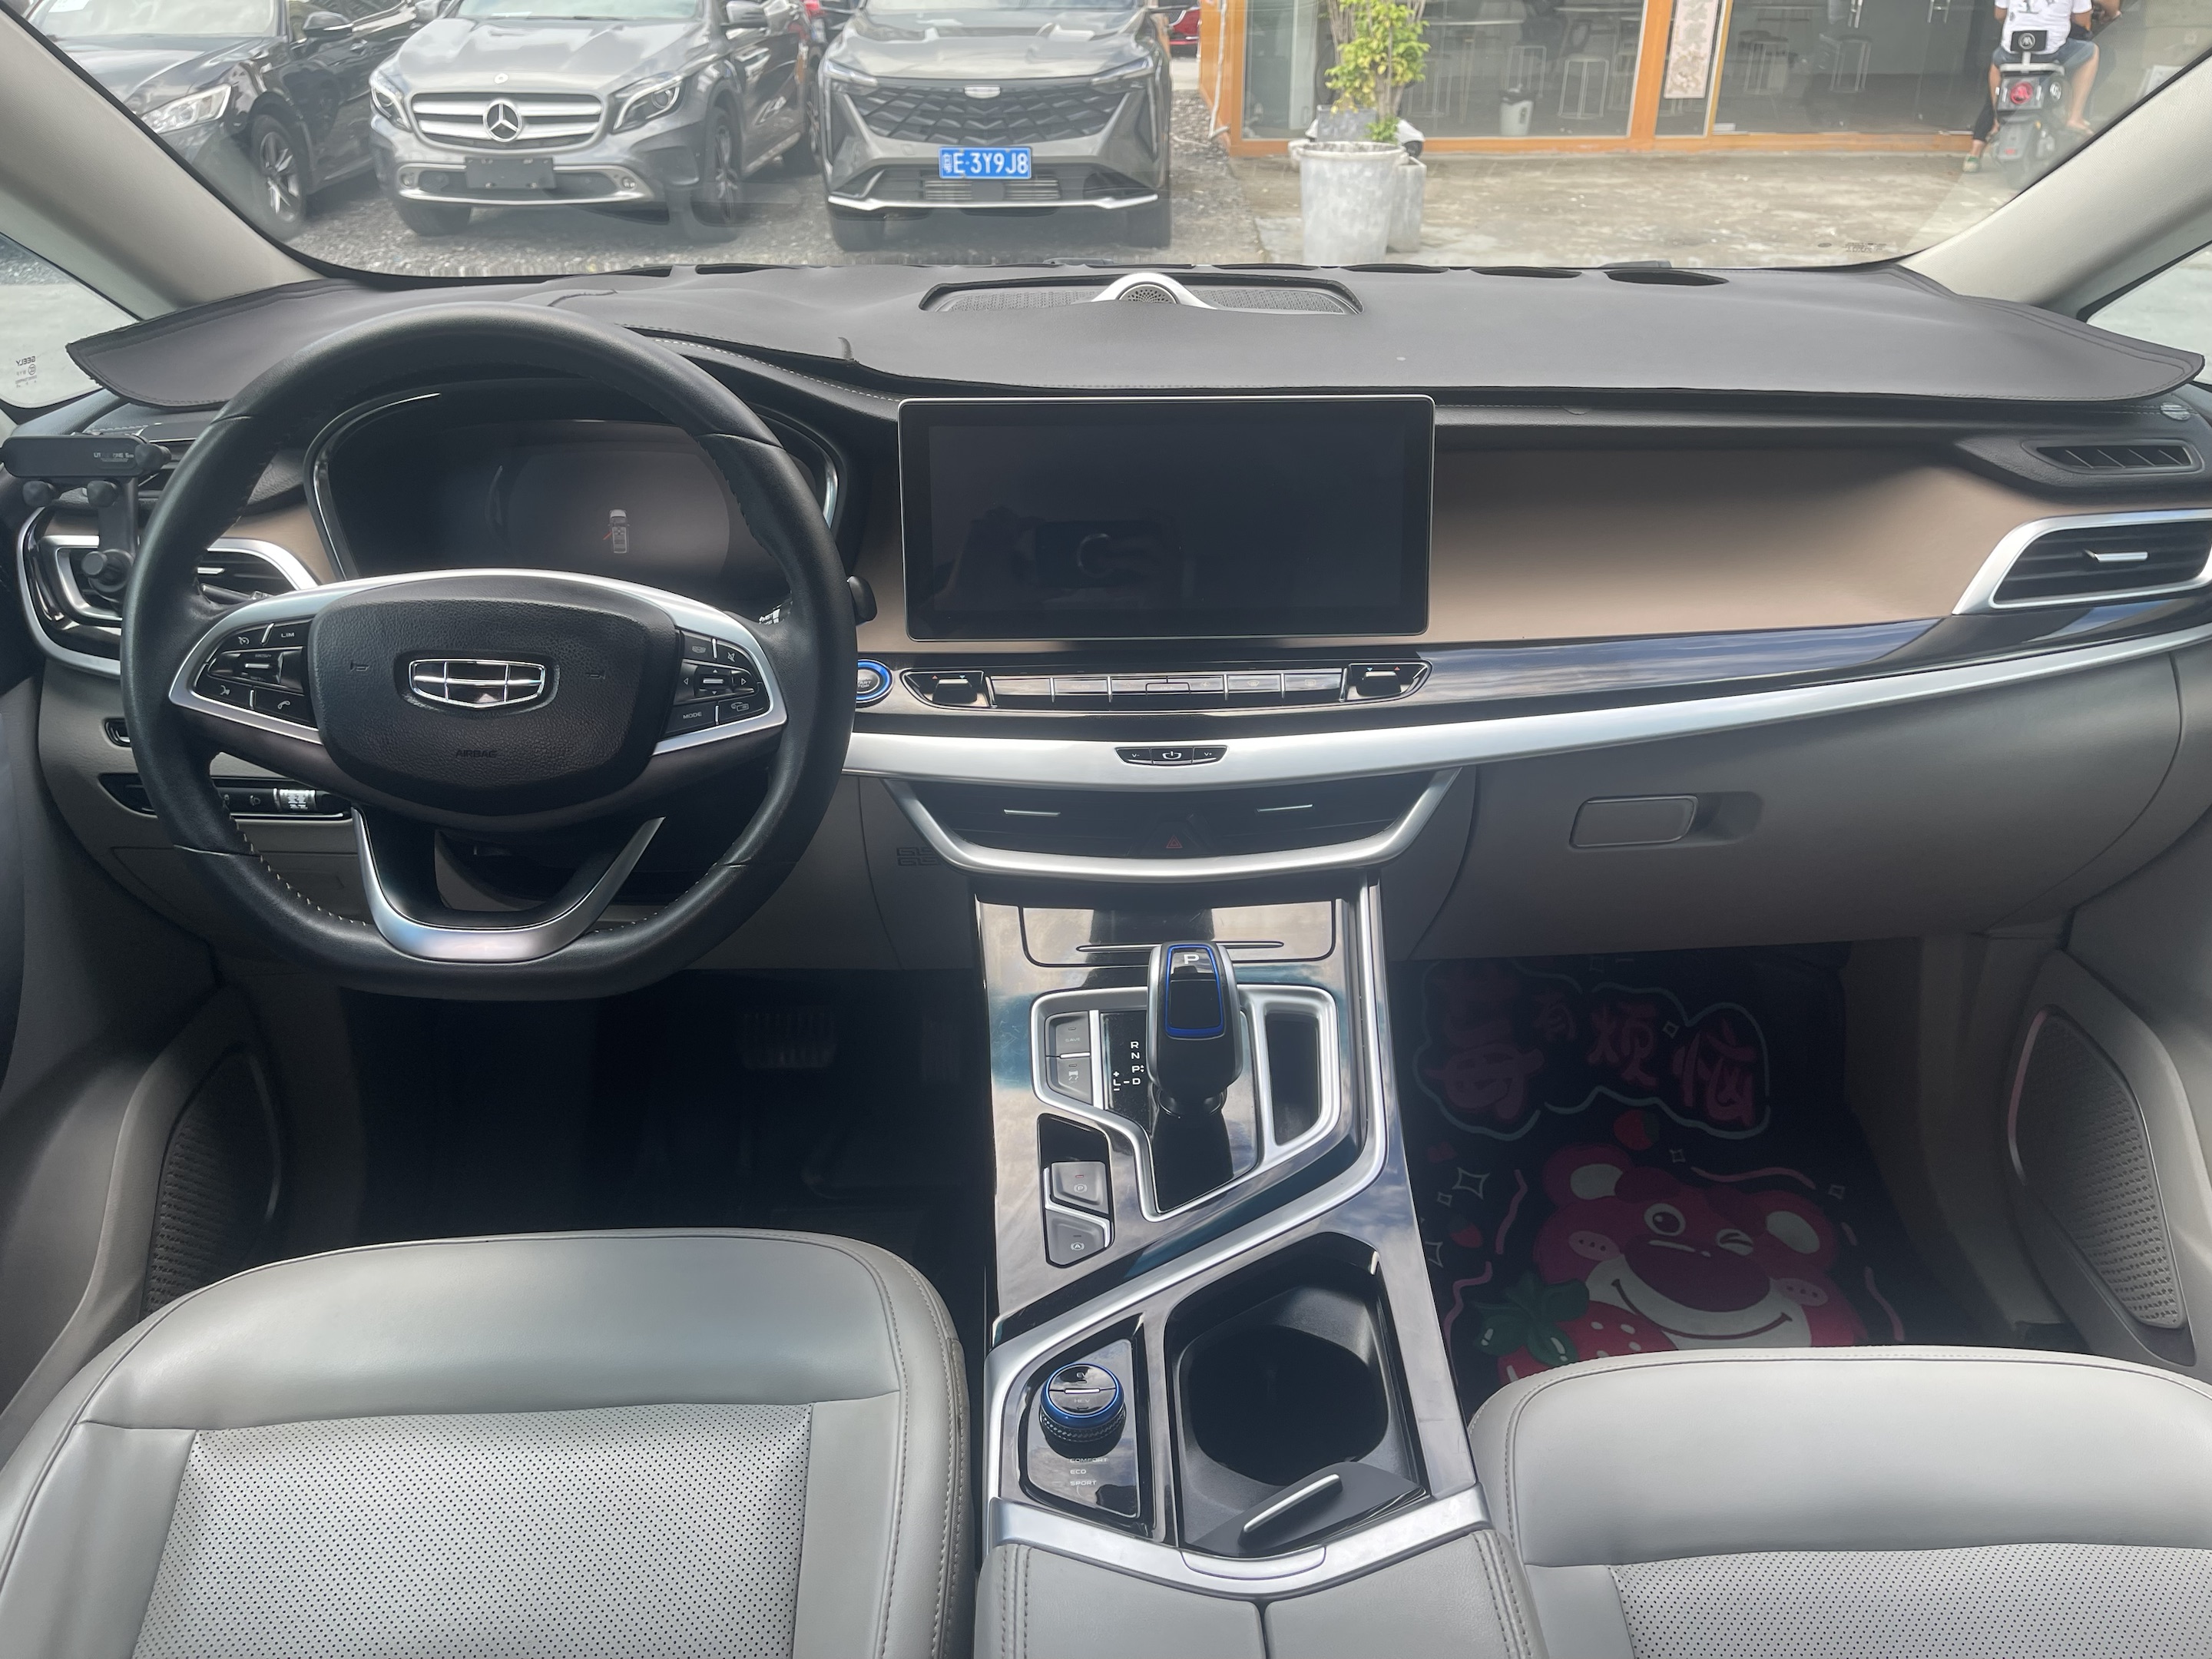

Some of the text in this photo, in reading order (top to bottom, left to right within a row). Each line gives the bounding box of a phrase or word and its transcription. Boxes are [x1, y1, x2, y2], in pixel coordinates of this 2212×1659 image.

[682, 711, 703, 720] MODE
[455, 750, 498, 758] AIRBAG
[1183, 954, 1200, 965] P
[1131, 1041, 1140, 1049] R
[1131, 1065, 1141, 1073] P
